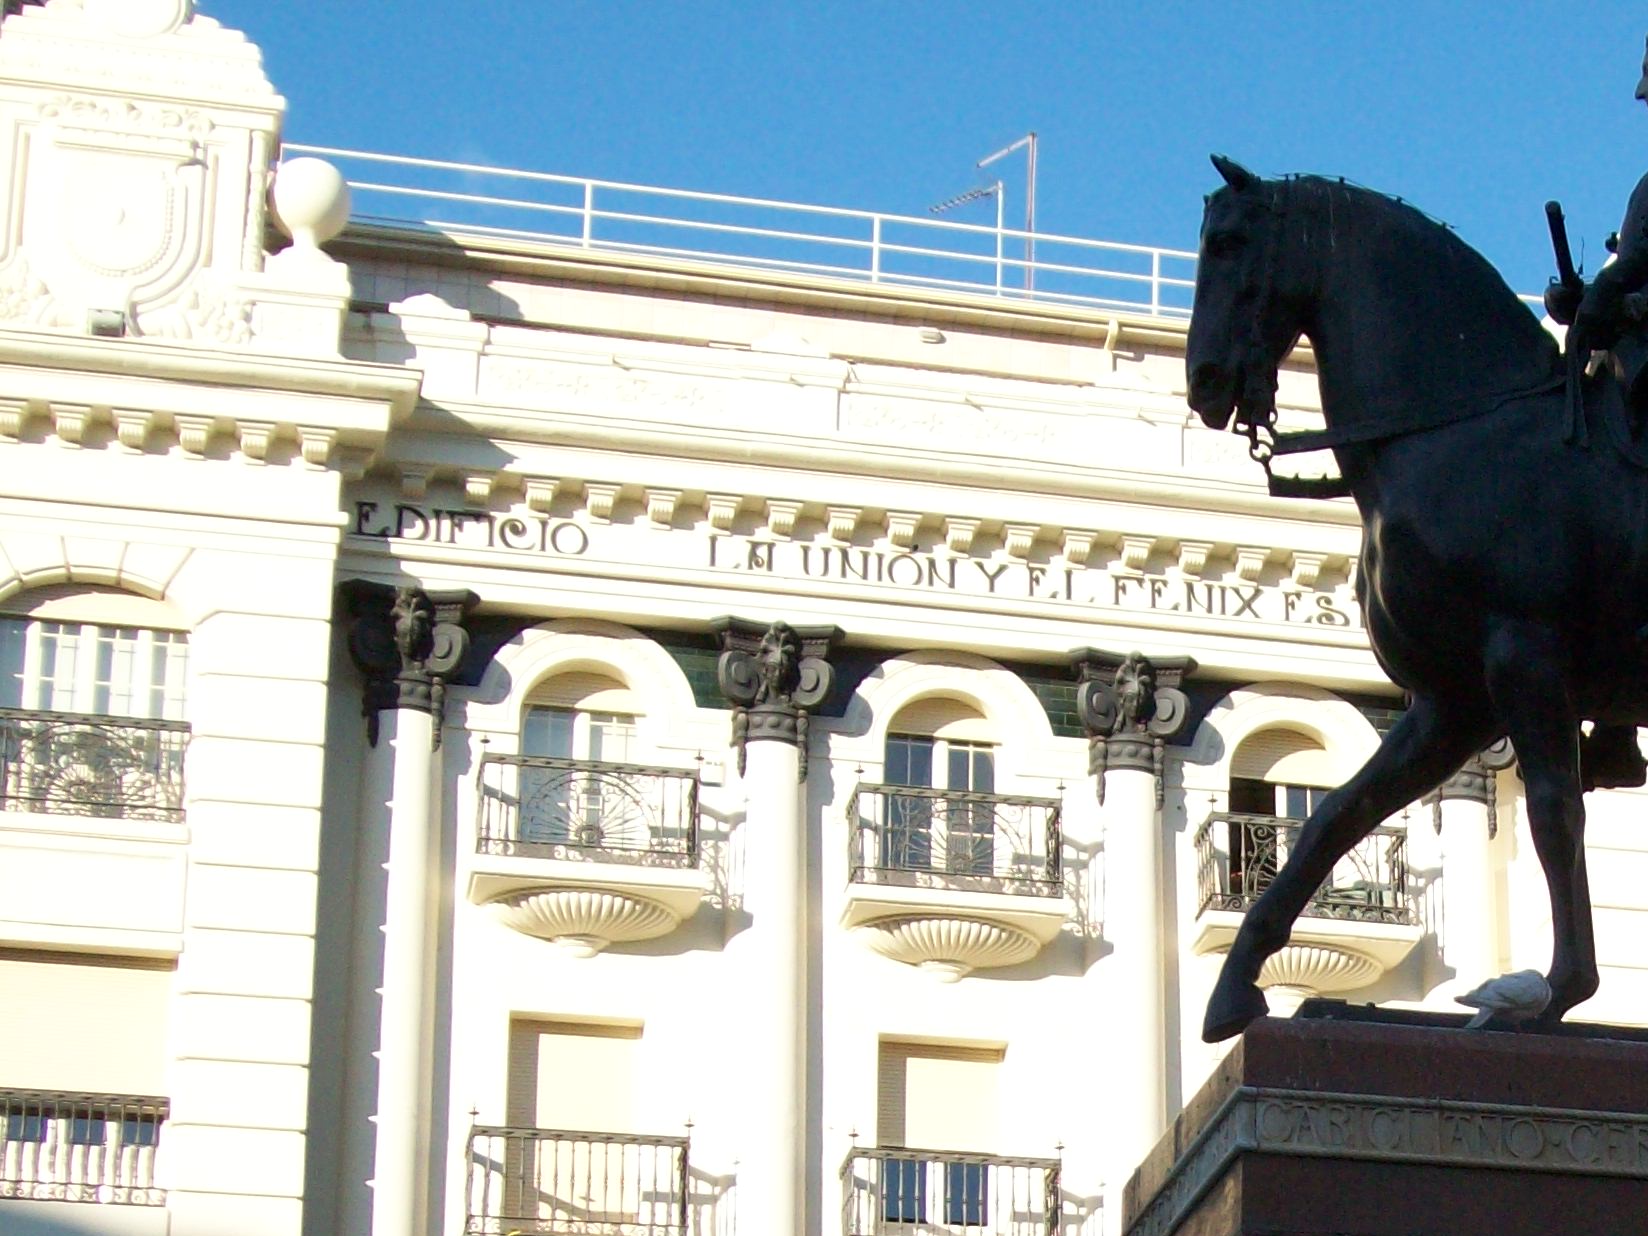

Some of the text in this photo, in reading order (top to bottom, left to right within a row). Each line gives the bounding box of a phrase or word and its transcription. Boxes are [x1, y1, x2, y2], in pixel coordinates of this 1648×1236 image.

[354, 501, 590, 555] EDIFICIO
[707, 534, 777, 572] LA
[974, 560, 1009, 593] Y
[1026, 564, 1096, 603] EL
[1111, 574, 1265, 619] FENIX
[1281, 589, 1363, 629] ES
